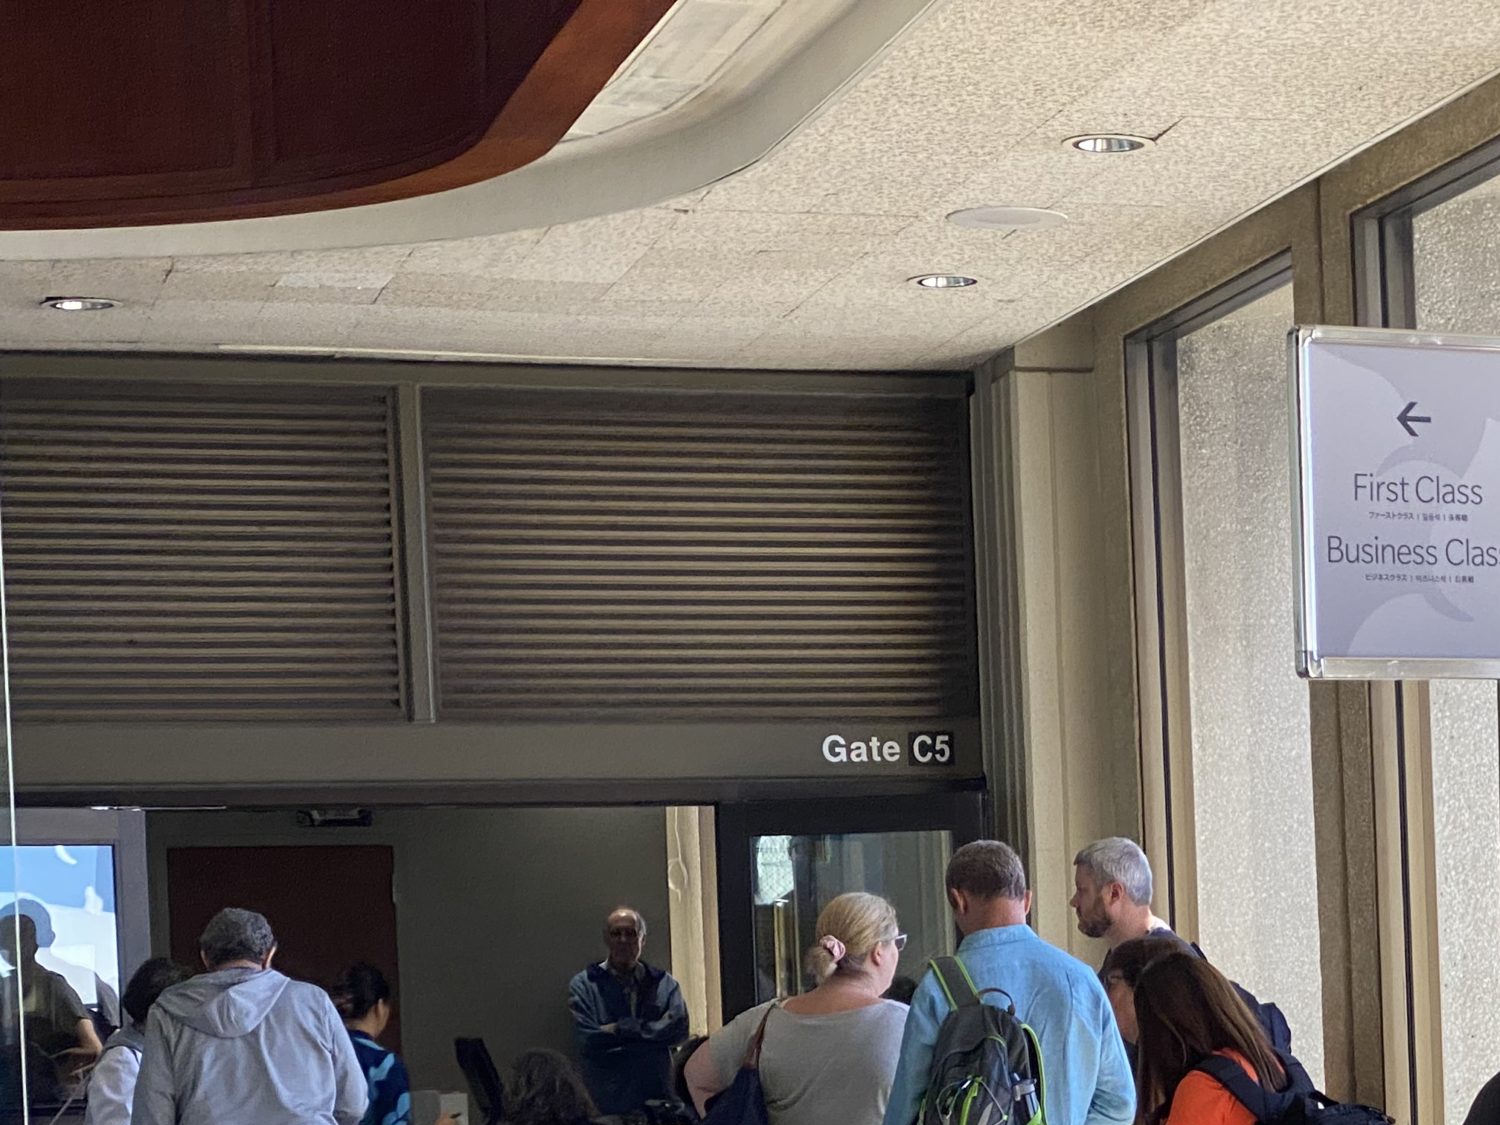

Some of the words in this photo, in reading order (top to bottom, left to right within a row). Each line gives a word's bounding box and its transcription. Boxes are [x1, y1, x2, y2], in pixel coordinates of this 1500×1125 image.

[1354, 472, 1410, 503] First
[1415, 474, 1483, 505] Class
[1327, 535, 1438, 565] Business
[822, 734, 901, 763] Gate
[912, 734, 951, 763] C5
